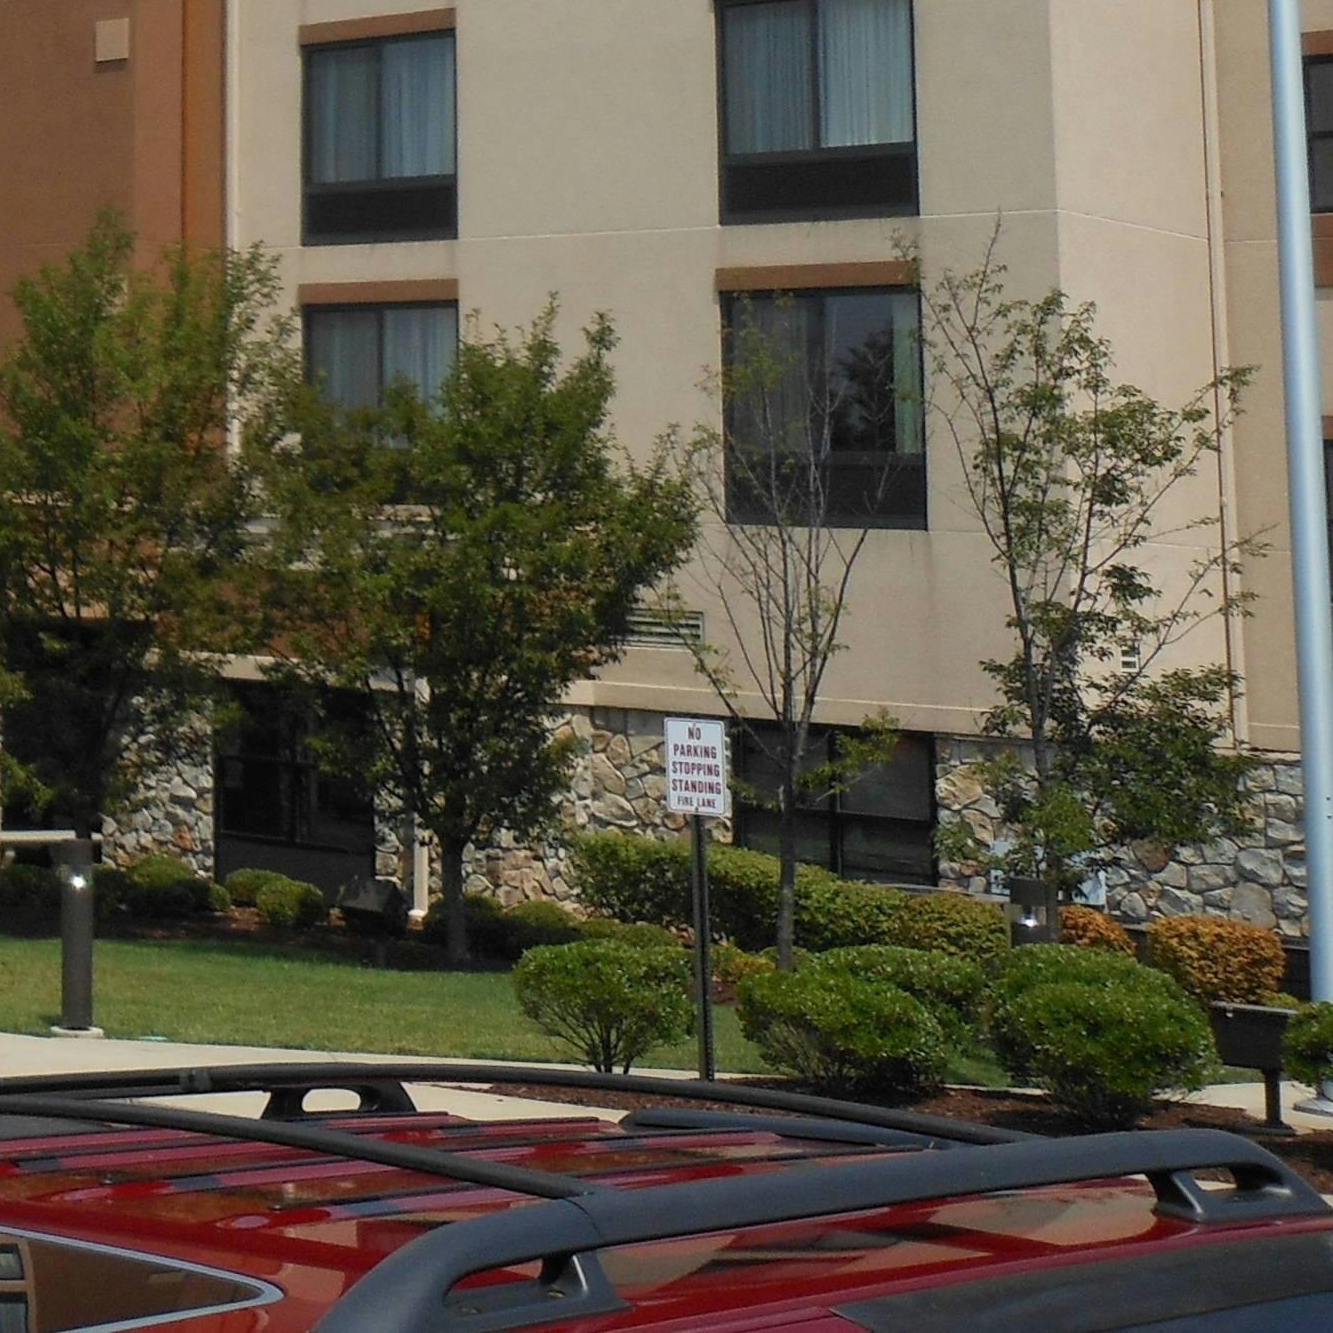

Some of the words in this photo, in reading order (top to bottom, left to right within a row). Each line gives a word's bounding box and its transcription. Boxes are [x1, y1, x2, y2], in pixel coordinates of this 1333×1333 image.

[688, 727, 701, 740] NO
[673, 743, 717, 759] PARKING
[671, 761, 720, 777] STOPPING
[671, 778, 722, 795] STANDING
[677, 795, 693, 806] FIRE
[697, 797, 716, 809] LANE
